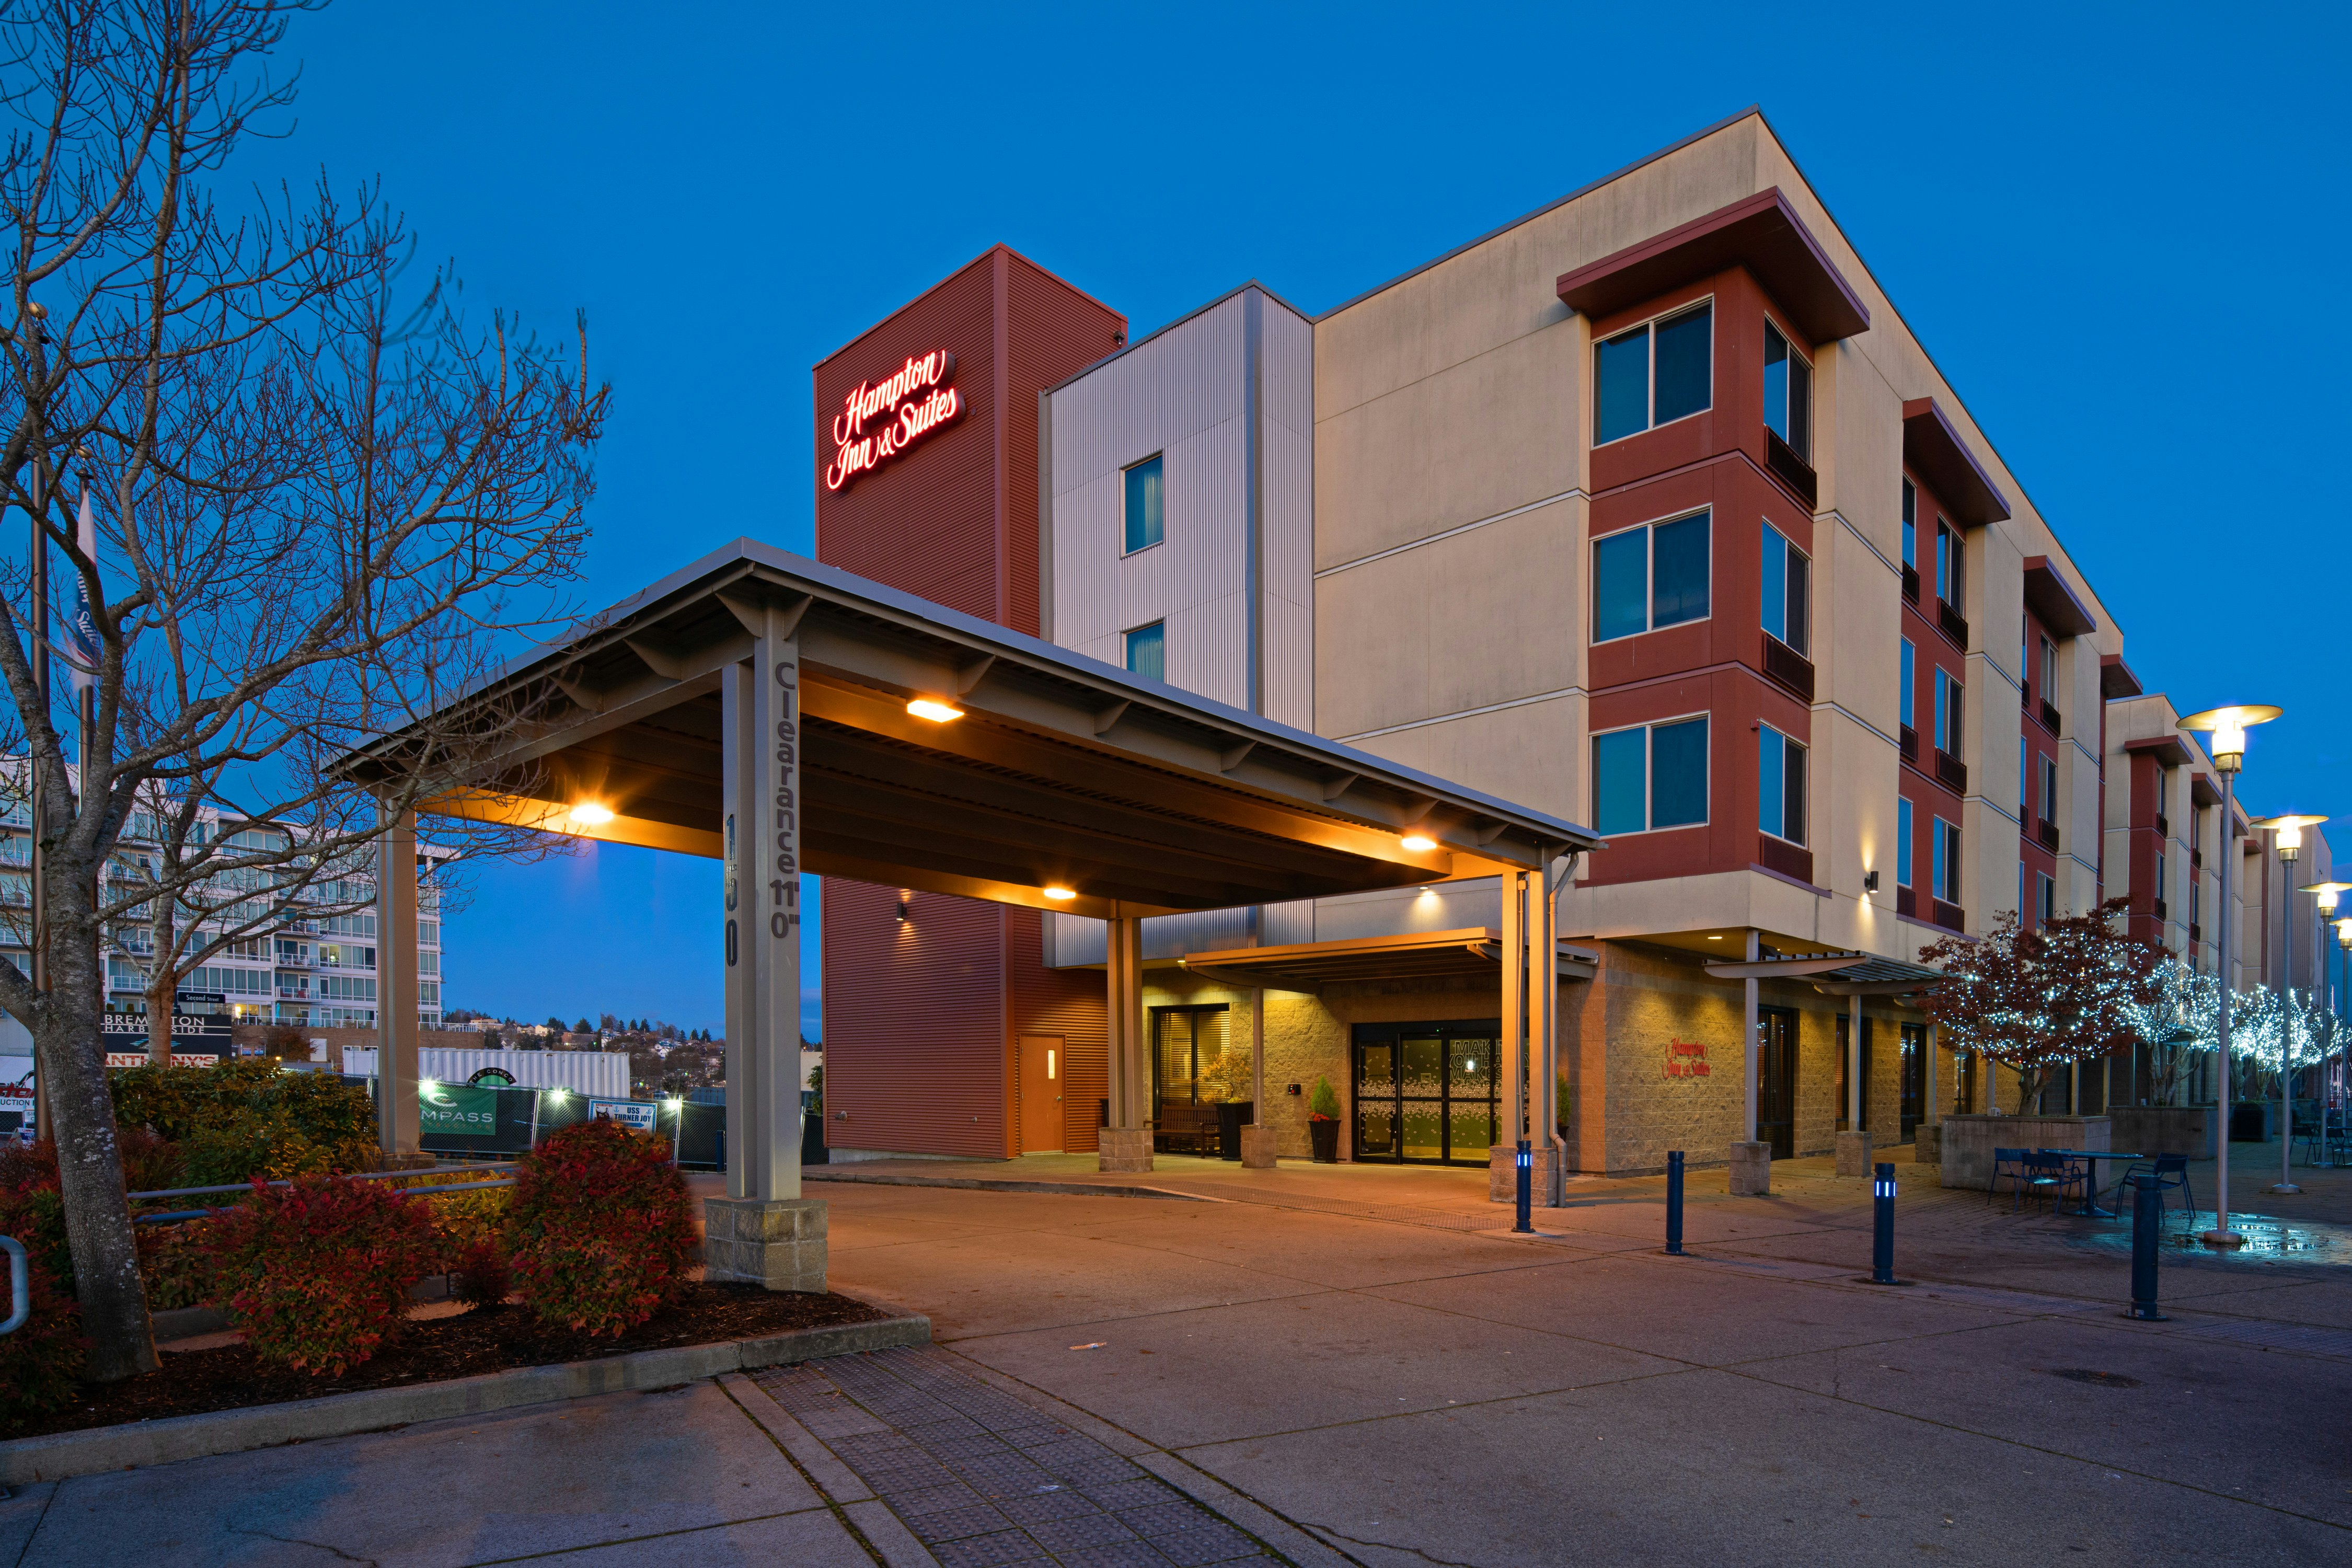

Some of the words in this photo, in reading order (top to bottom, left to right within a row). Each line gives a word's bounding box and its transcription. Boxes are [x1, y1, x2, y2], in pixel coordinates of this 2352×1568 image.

[834, 349, 946, 446] Hampton
[827, 435, 880, 490] Inn
[880, 427, 896, 456] &
[892, 388, 956, 447] Suites
[775, 662, 796, 874] Clearance
[725, 814, 737, 966] 150
[105, 1014, 204, 1025] BREMTON
[105, 1025, 204, 1034] HARBSIDE
[1666, 1037, 1708, 1059] Hampton
[105, 1055, 215, 1067] NTNY'S
[1662, 1059, 1685, 1079] Inn
[1688, 1059, 1710, 1077] Suites
[469, 1072, 482, 1083] THE
[487, 1069, 513, 1082] CONCO
[421, 1110, 493, 1122] MPASS
